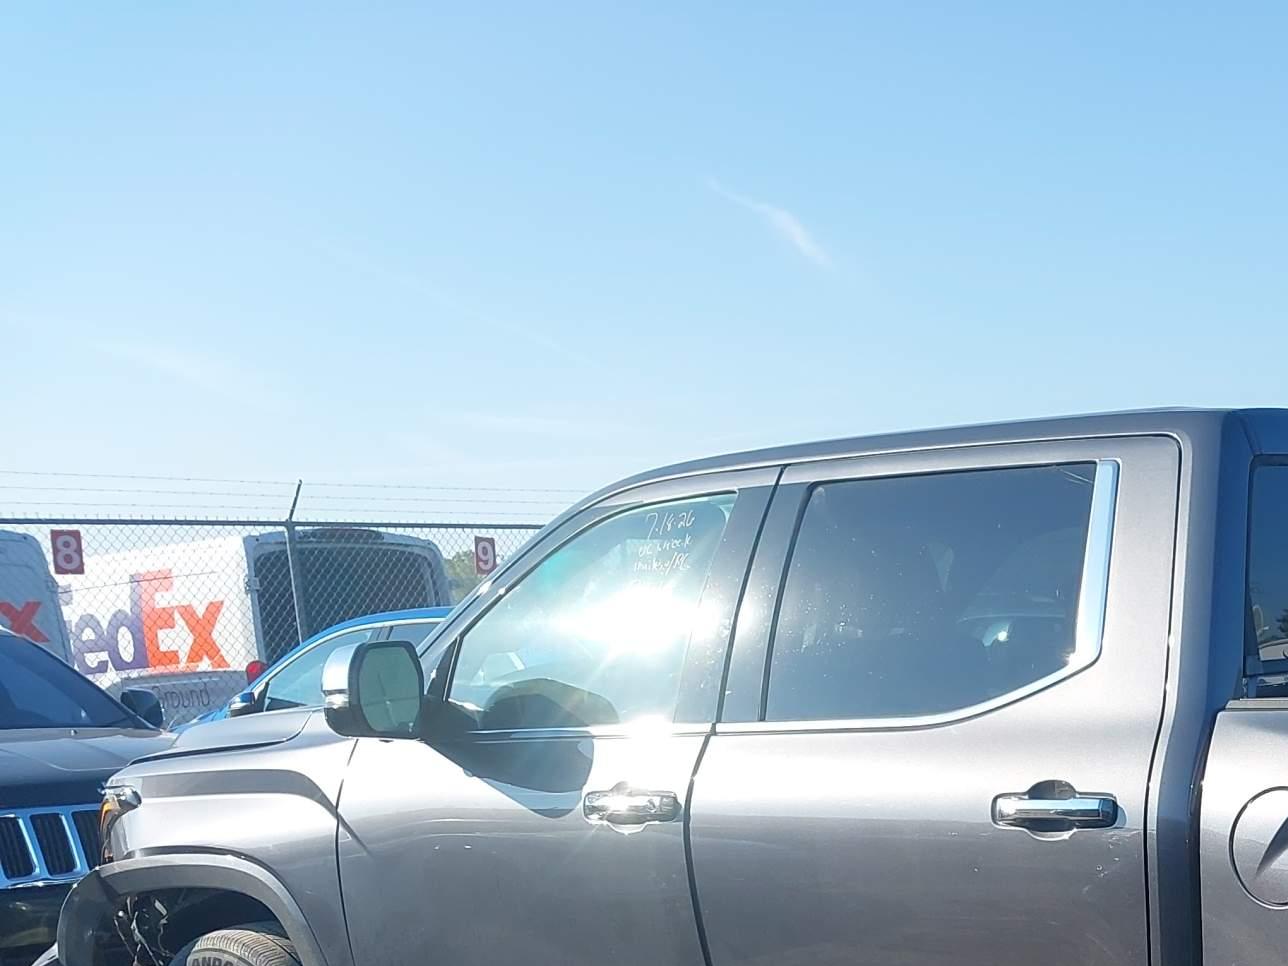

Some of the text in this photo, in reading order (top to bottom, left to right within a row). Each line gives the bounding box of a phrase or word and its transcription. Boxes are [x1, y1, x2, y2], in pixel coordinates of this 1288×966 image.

[56, 535, 81, 570] 8
[477, 541, 494, 570] 9
[57, 568, 231, 674] edEx
